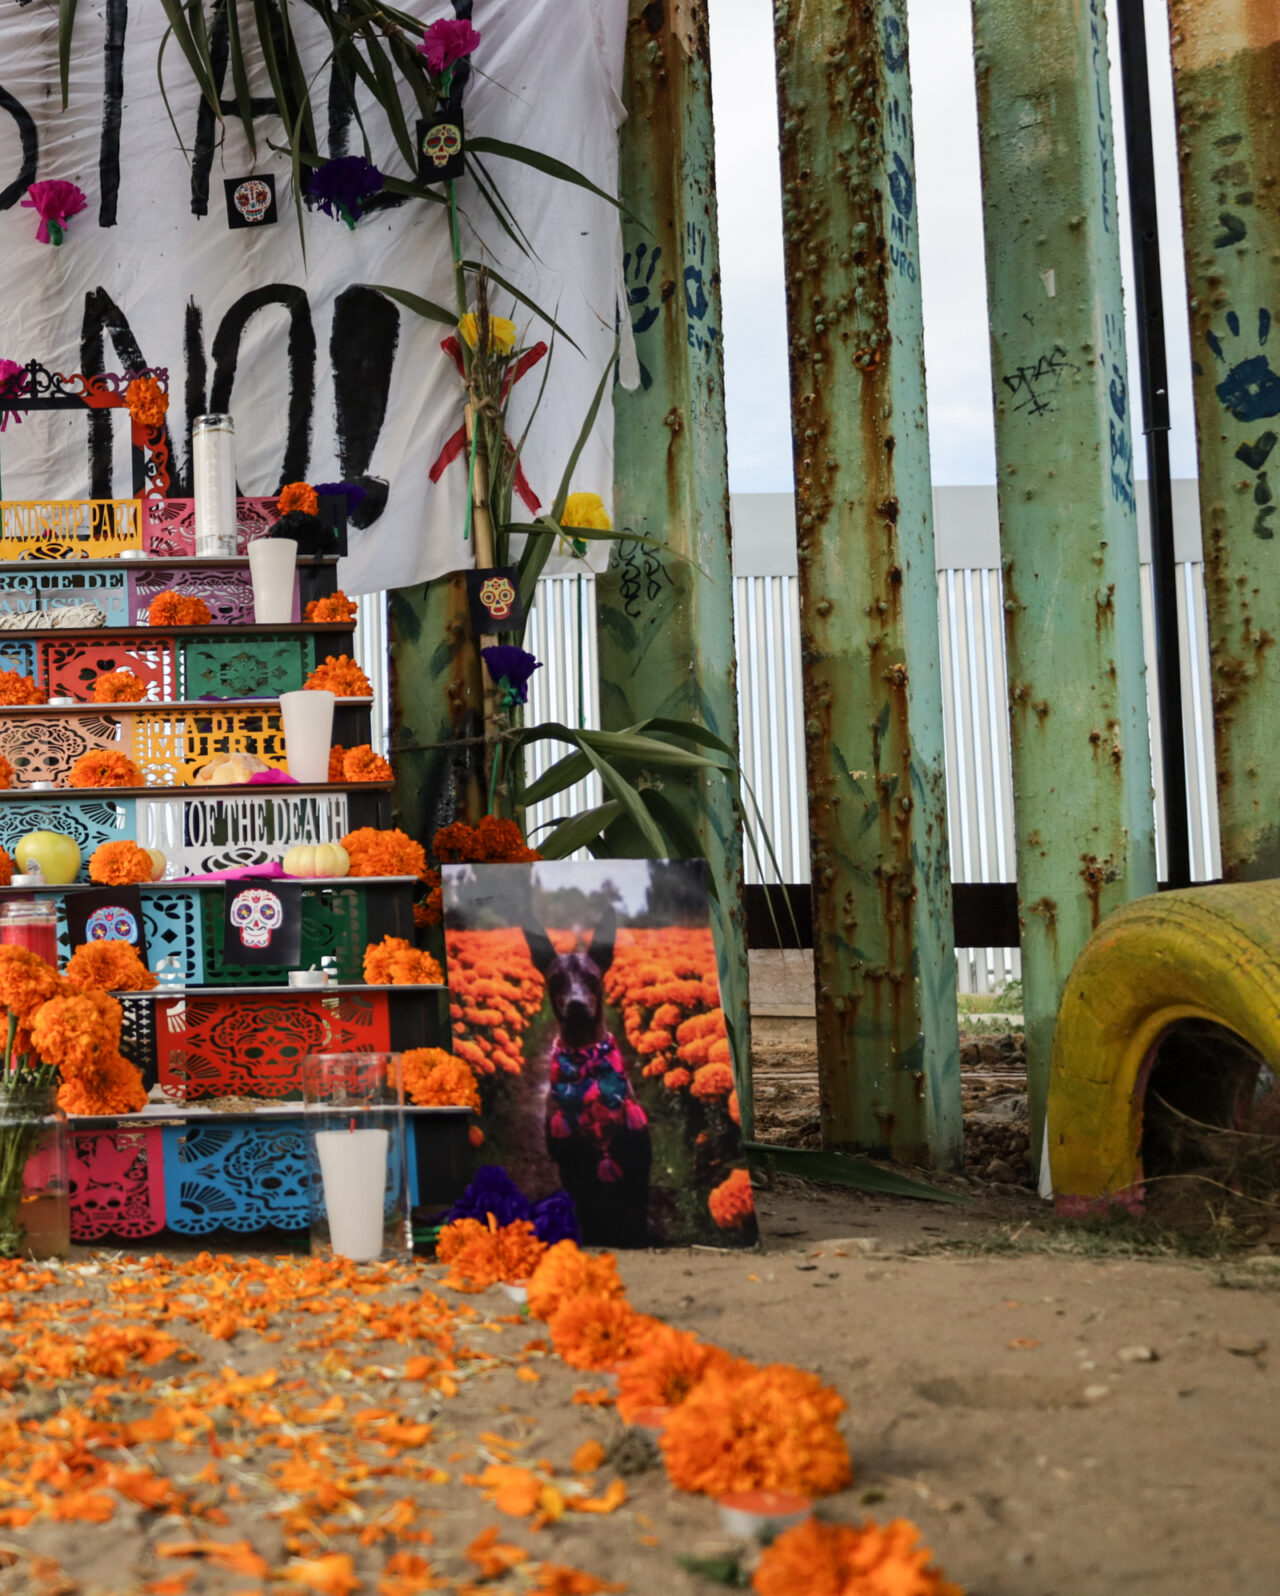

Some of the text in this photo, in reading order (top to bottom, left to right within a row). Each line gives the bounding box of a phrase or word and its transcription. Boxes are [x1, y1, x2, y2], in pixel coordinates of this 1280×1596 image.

[90, 503, 138, 542] PARK
[82, 572, 123, 590] DE
[150, 716, 198, 735] DIA
[212, 715, 249, 734] DE
[150, 735, 287, 758] MUERTO
[188, 799, 216, 847] OF
[221, 797, 267, 846] THE
[271, 793, 347, 845] DEATH
